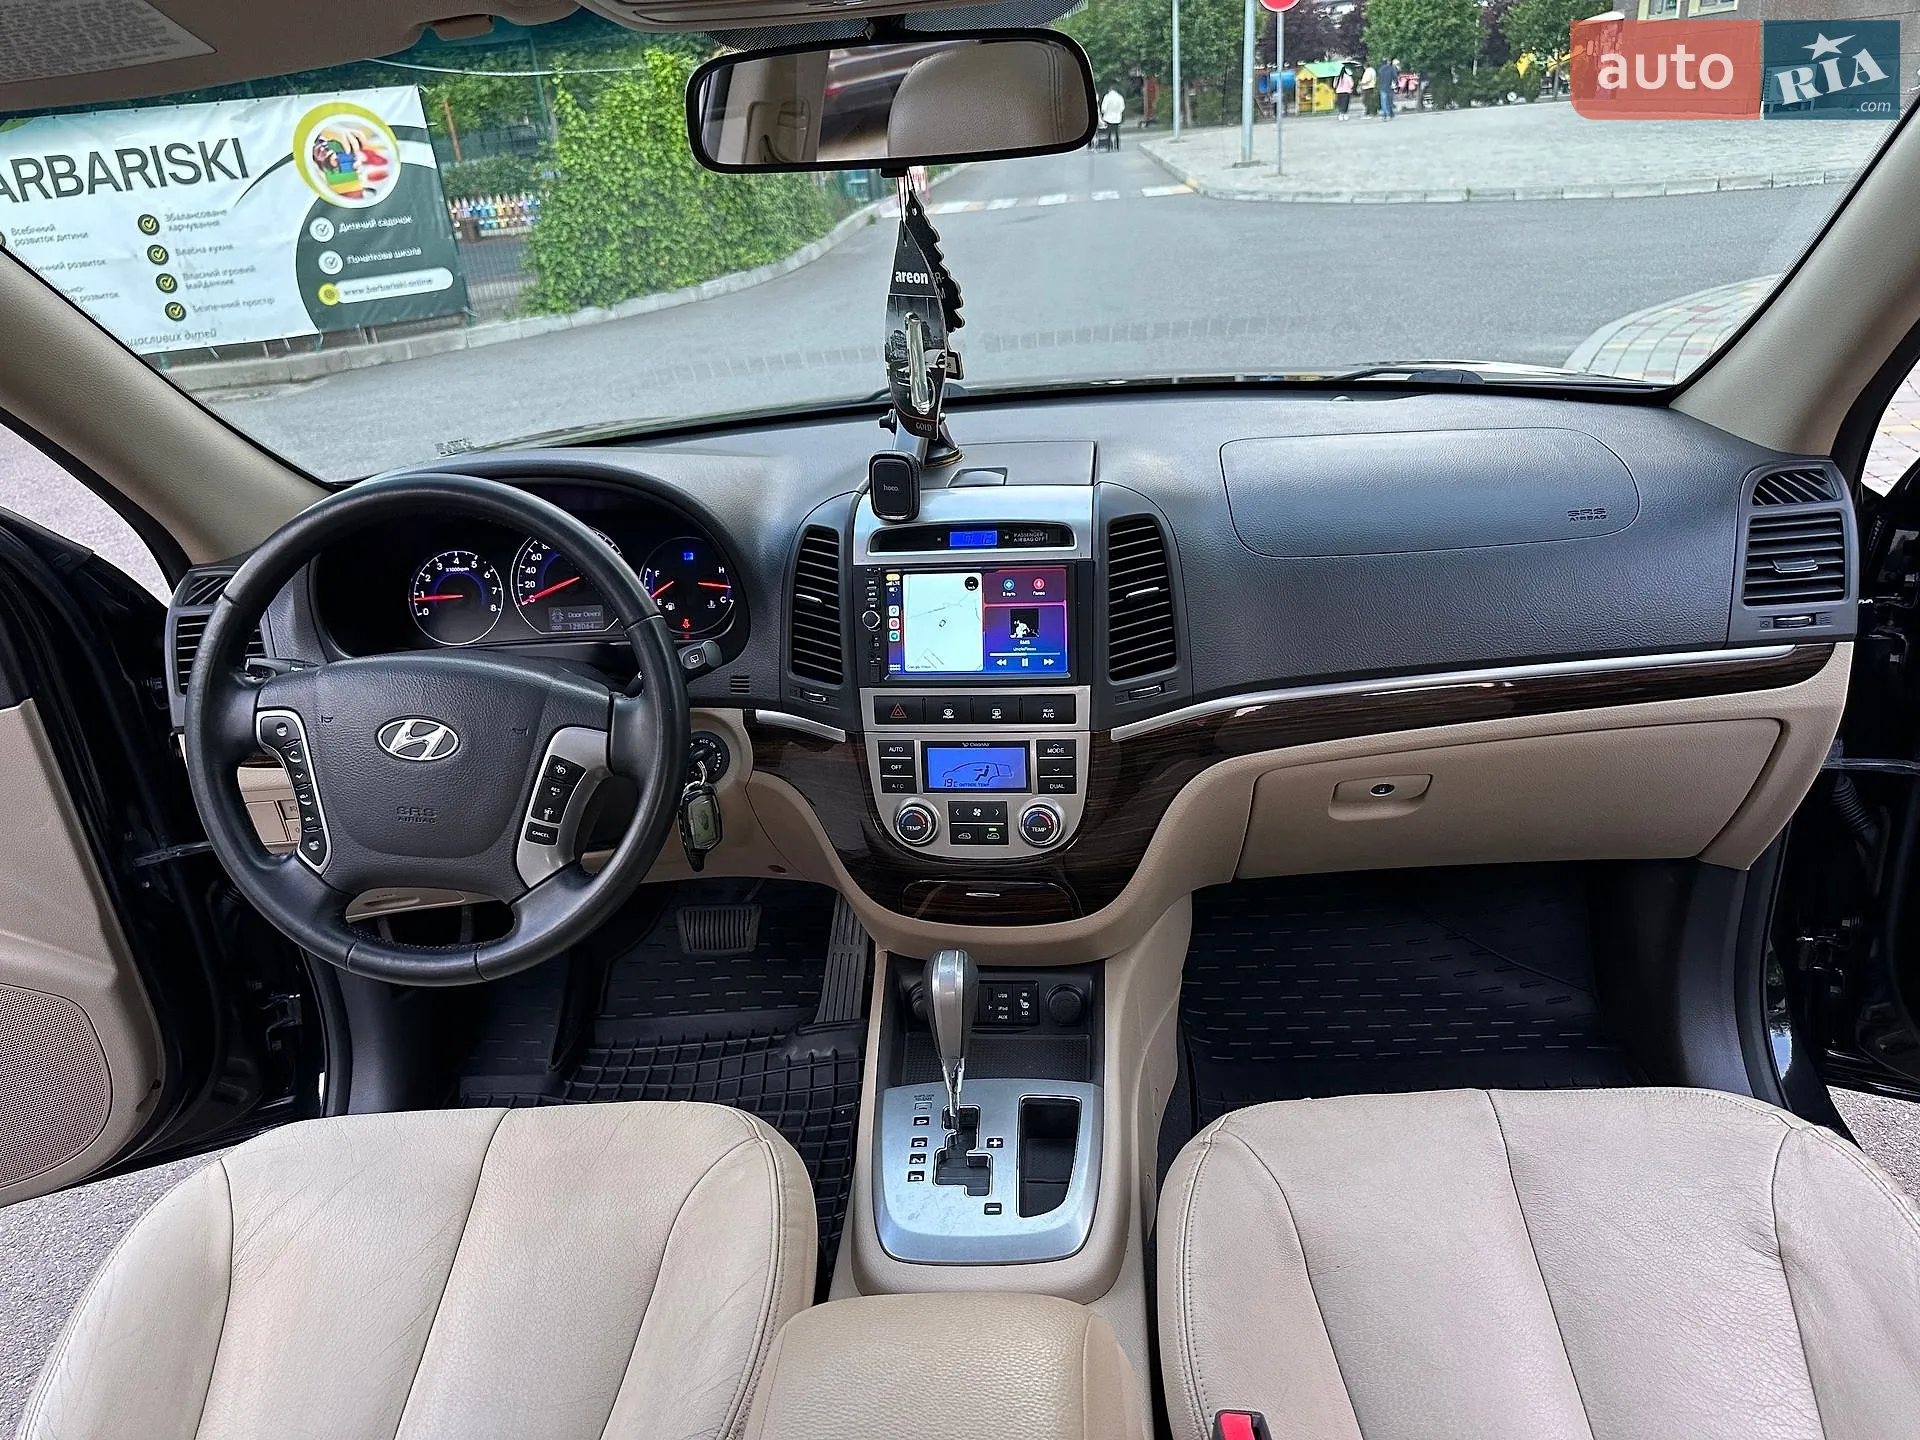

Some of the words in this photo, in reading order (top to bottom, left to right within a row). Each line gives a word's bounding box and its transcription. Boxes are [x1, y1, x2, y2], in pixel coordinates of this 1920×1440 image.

[14, 235, 55, 248] розвиток
[894, 270, 929, 285] areon
[531, 553, 542, 561] 60
[436, 562, 443, 570] 3
[471, 560, 478, 568] 5
[525, 566, 537, 574] 40
[718, 566, 725, 574] H
[425, 574, 432, 582] 2
[484, 571, 491, 579] 6
[524, 581, 536, 589] 20
[491, 587, 497, 595] 7
[423, 608, 429, 616] 0
[490, 604, 497, 612] 8
[531, 830, 550, 839] CANCEL
